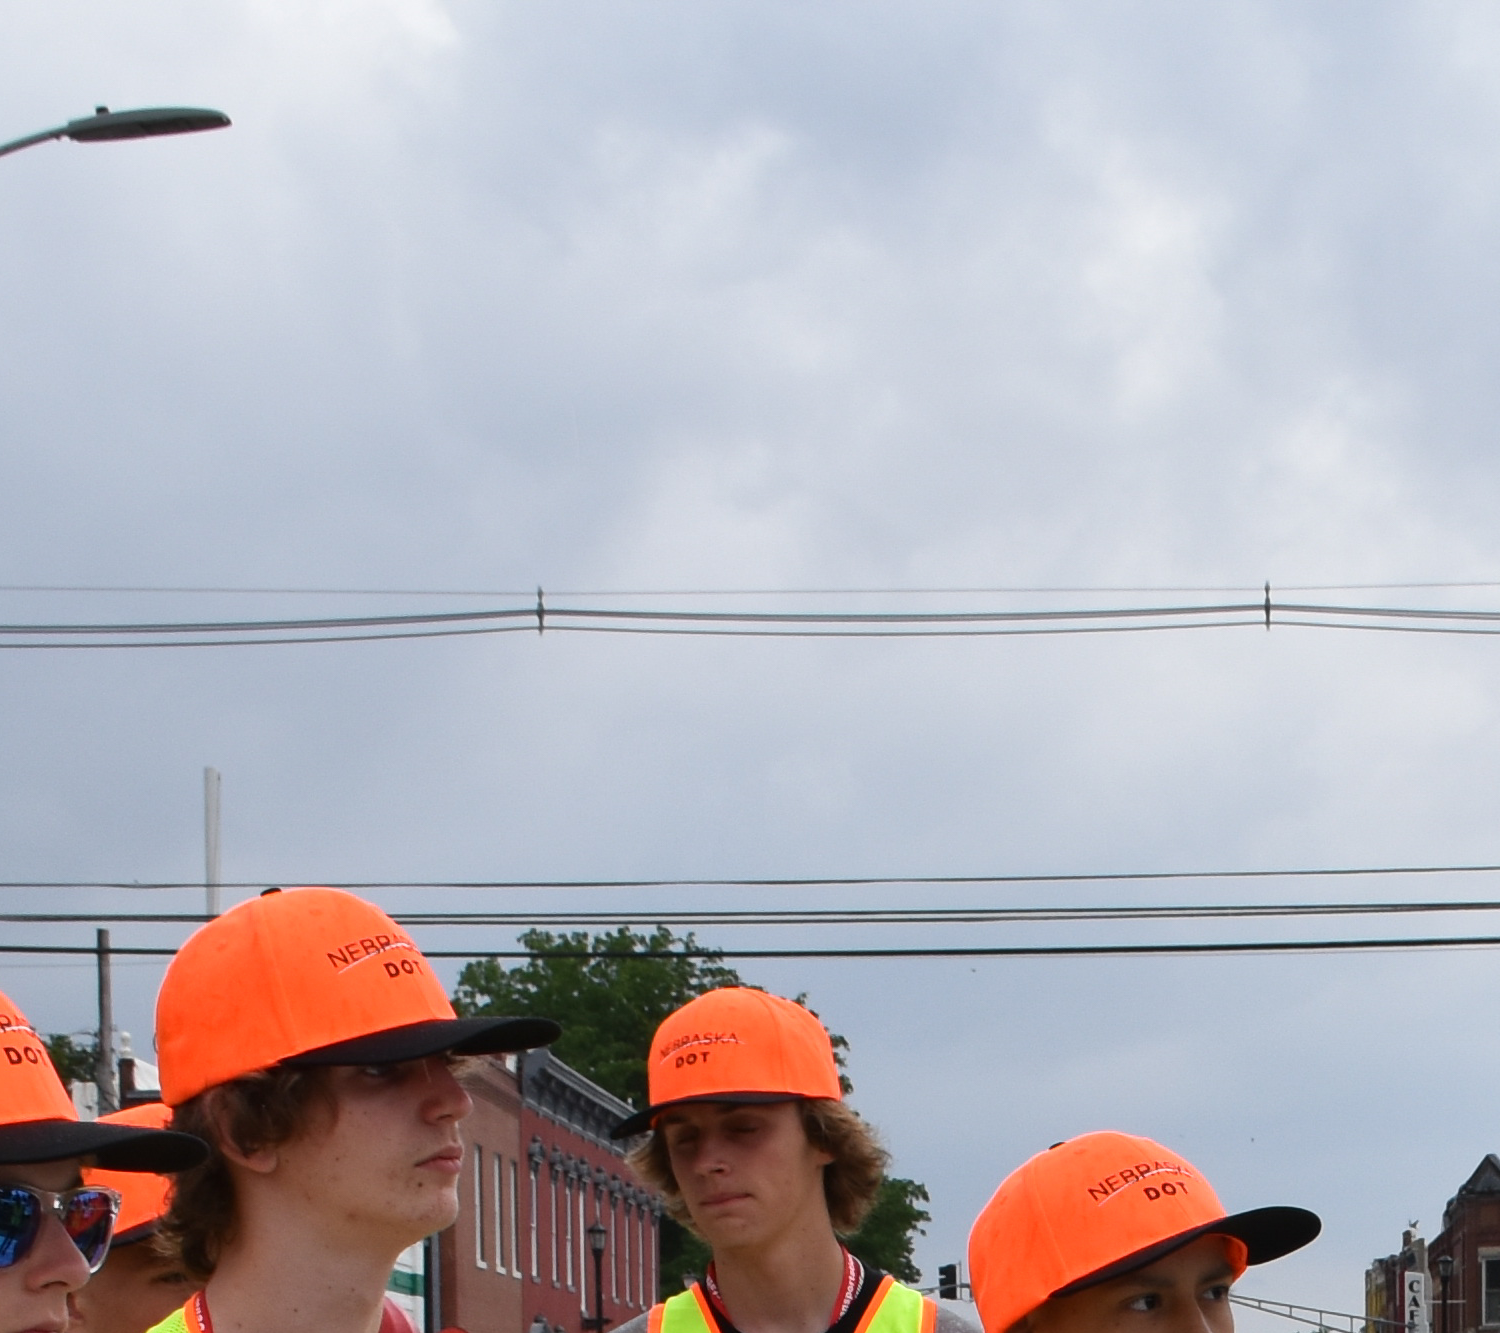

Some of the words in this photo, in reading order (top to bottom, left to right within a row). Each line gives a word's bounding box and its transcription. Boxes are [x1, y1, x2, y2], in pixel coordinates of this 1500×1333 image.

[383, 959, 424, 979] DOT
[3, 1045, 48, 1066] DOT
[675, 1051, 711, 1068] DOT
[1143, 1181, 1188, 1201] DOT
